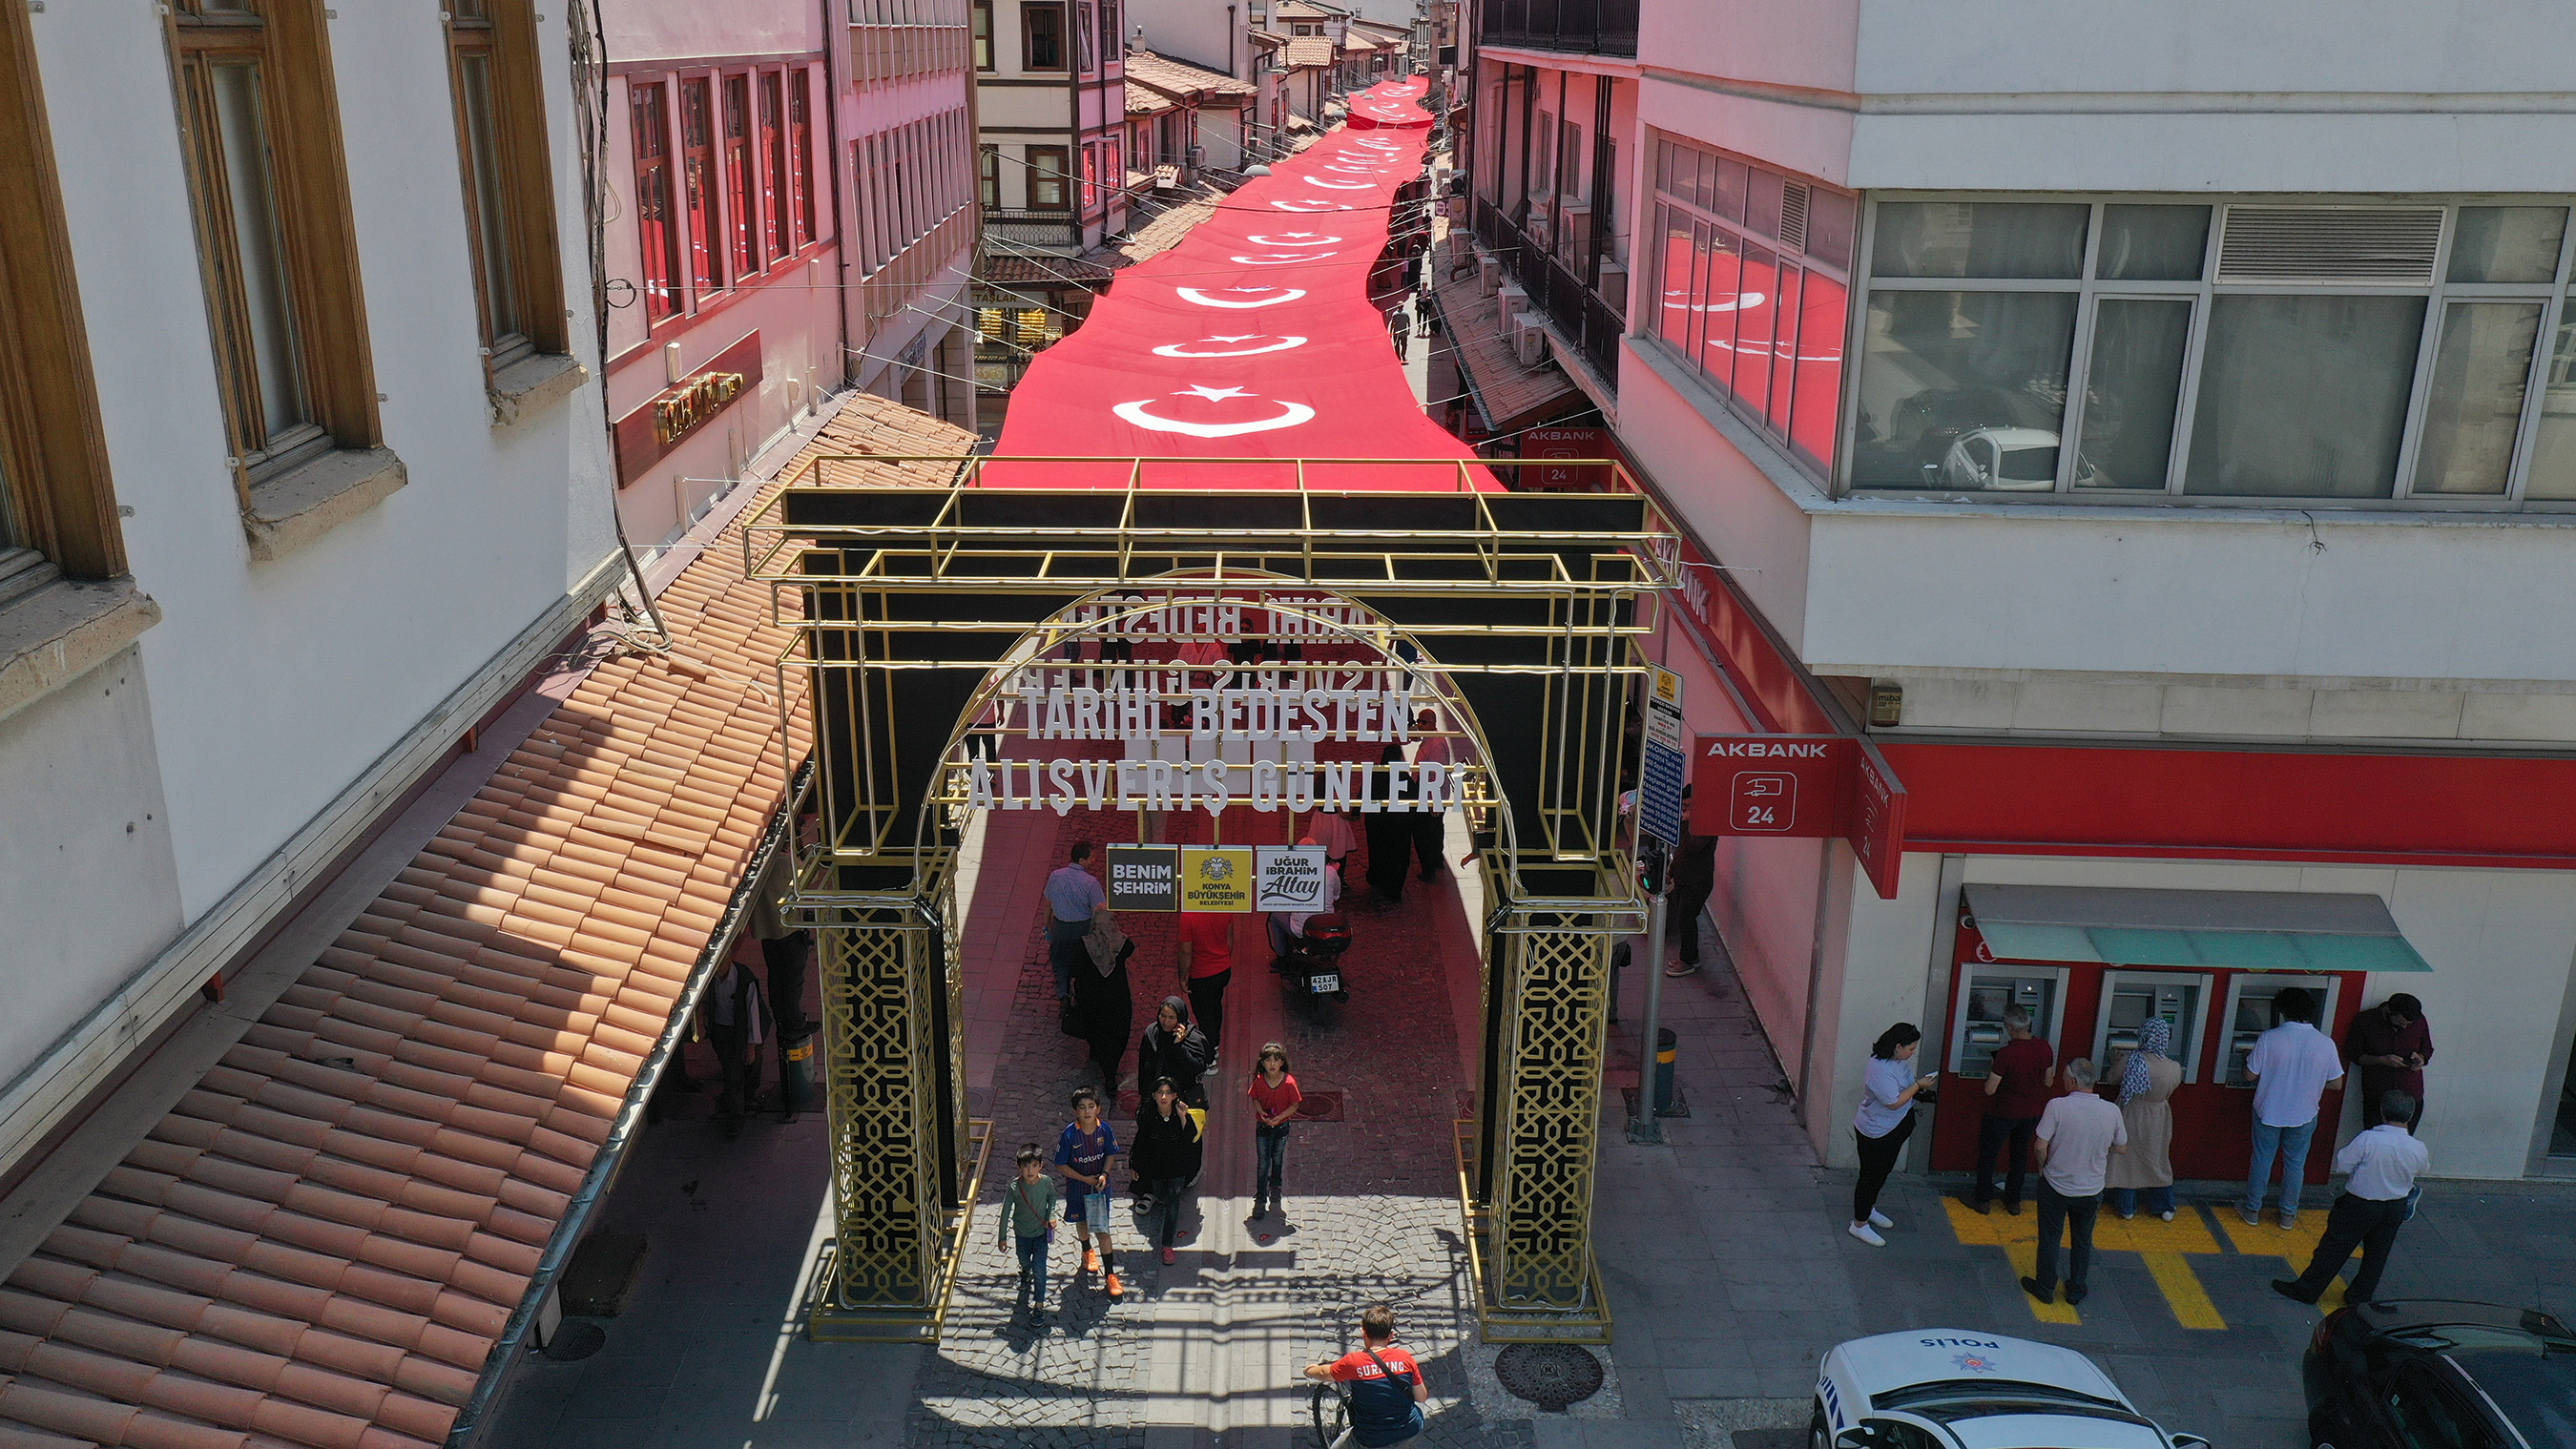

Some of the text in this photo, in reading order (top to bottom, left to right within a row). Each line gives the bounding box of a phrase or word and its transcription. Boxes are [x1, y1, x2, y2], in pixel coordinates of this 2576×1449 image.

[1528, 431, 1595, 441] AKBANK
[1551, 469, 1567, 480] 24
[1654, 530, 1711, 626] AKANK
[1019, 688, 1411, 743] TARİHİ BEDESTEN
[1707, 743, 1828, 757] AKBANK
[968, 758, 1465, 818] ALIŞVERİŞ GÜNLERİ
[1748, 806, 1774, 824] 24
[1275, 856, 1309, 866] UĞUR
[1112, 864, 1172, 880] BENİM
[1112, 881, 1172, 896] ŞEHRİM
[1188, 890, 1245, 900] BÜYÜKŞEHİR
[1260, 876, 1321, 902] Altay
[1920, 1338, 2000, 1350] POLİS
[1357, 1361, 1404, 1377] SURNG
